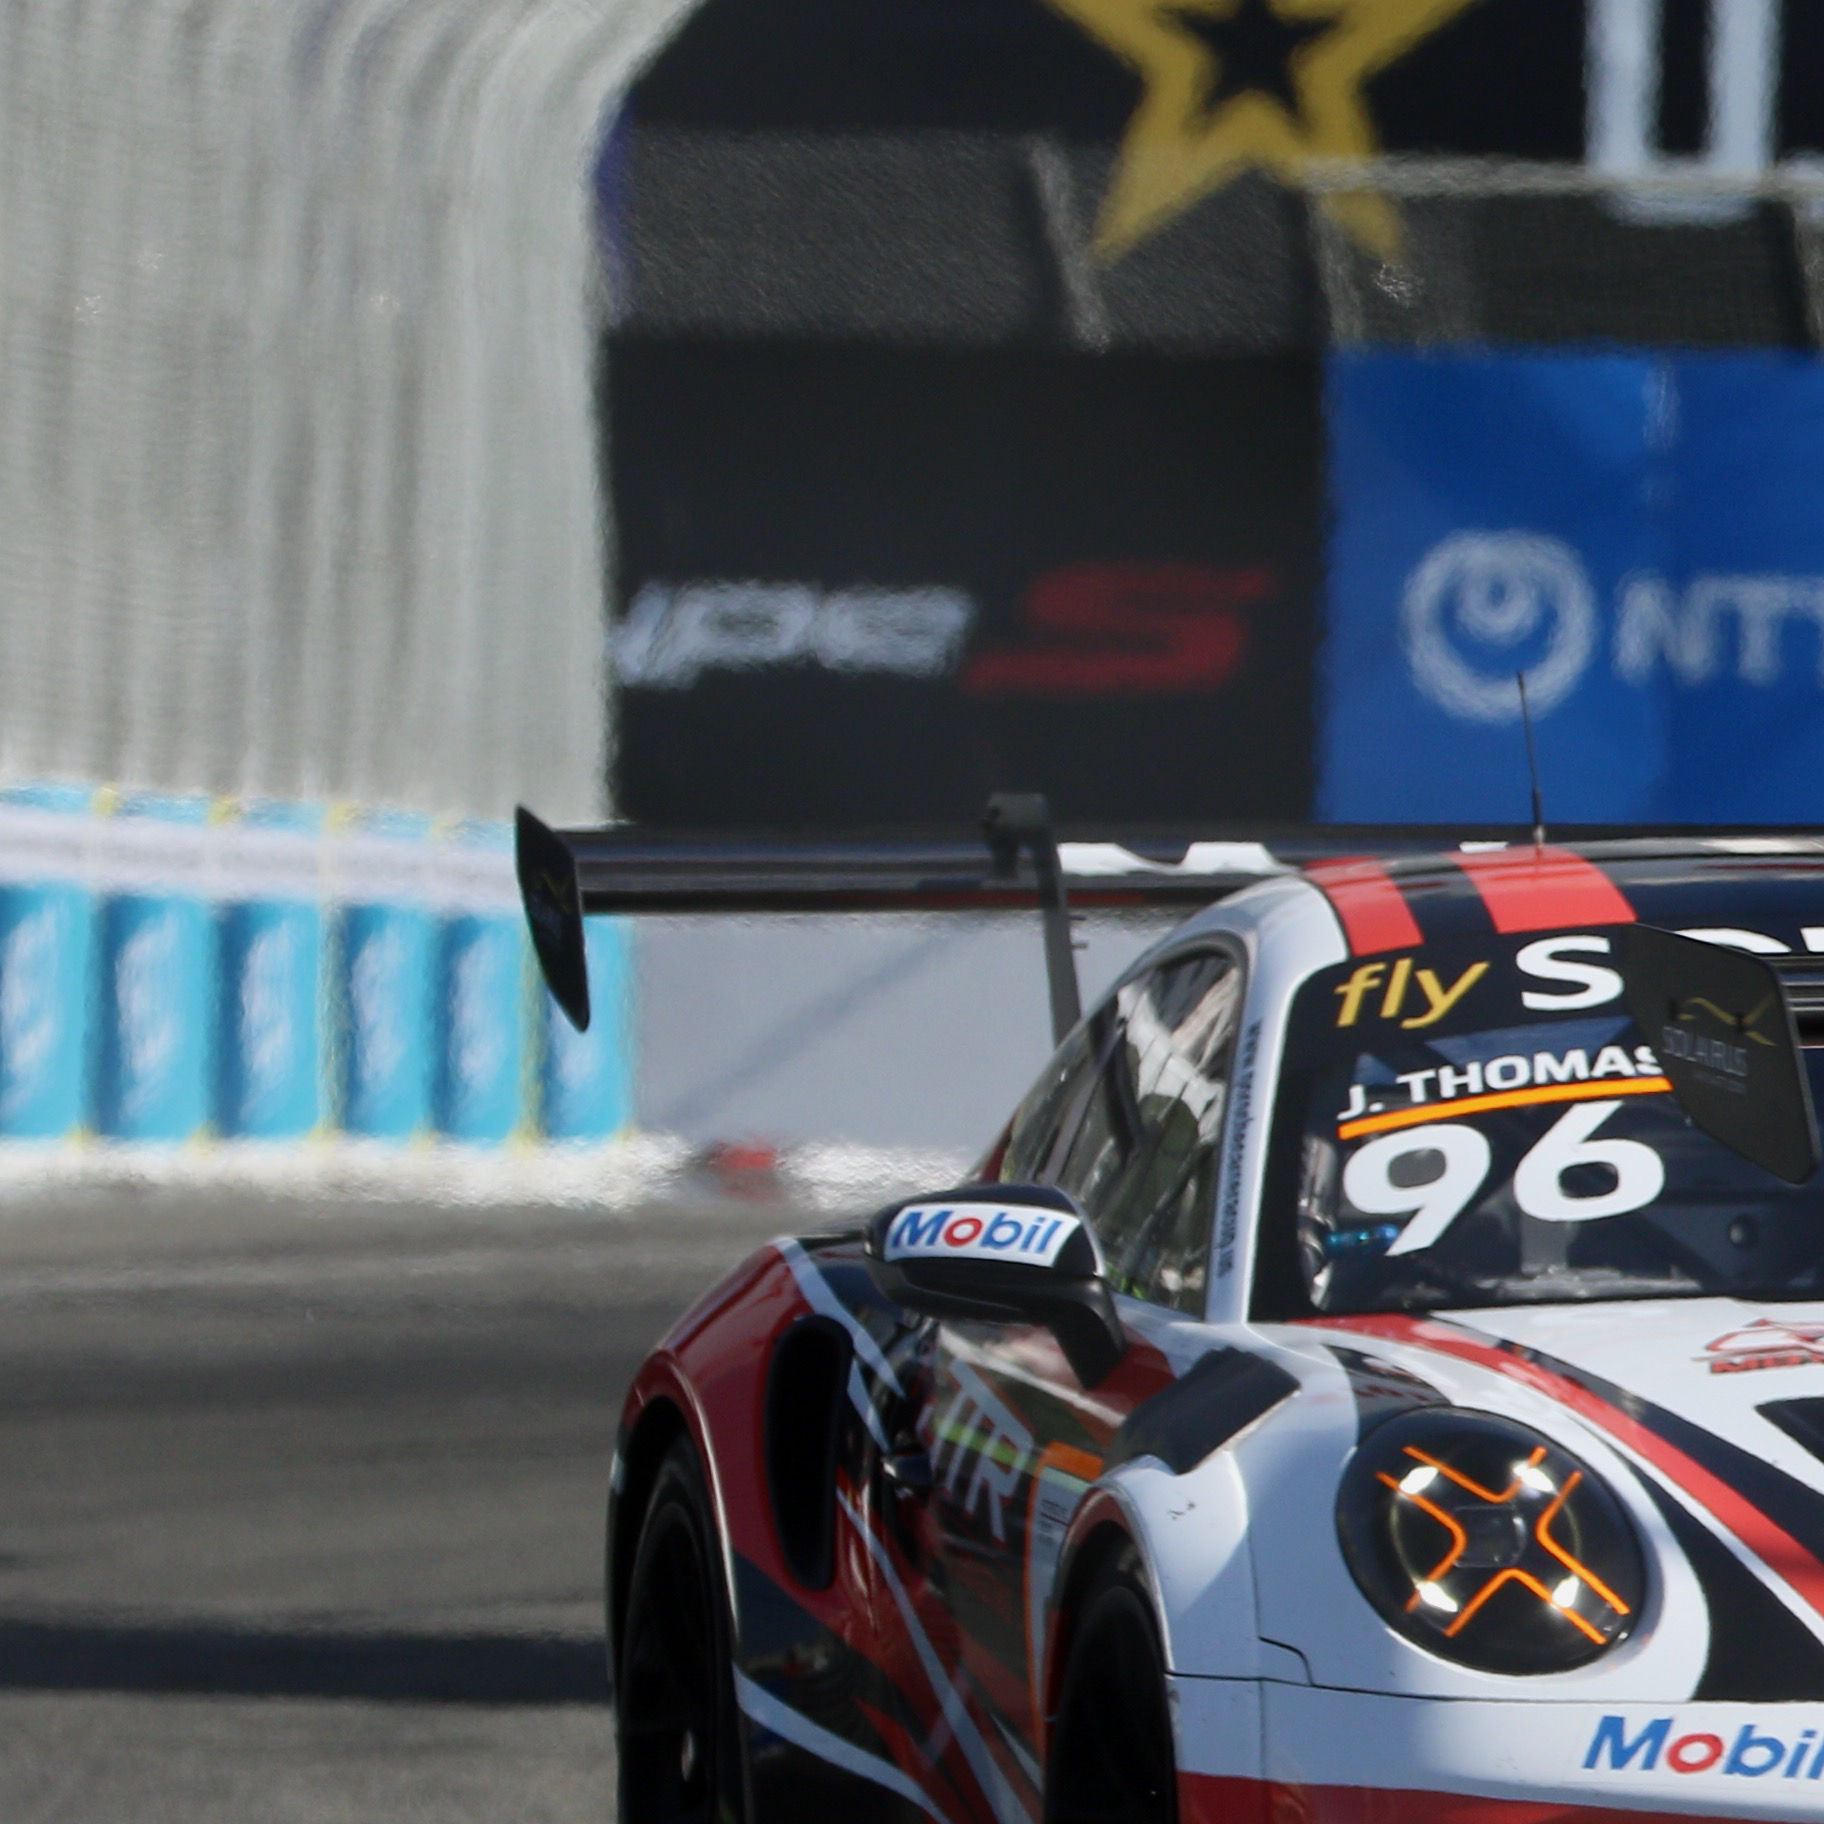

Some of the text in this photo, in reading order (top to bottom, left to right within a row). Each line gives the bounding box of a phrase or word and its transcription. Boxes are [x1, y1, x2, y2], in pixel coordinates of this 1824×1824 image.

[1334, 956, 1490, 1029] fly
[1337, 1083, 1383, 1122] J.
[1398, 1043, 1662, 1104] THOMAS
[1342, 1099, 1664, 1257] 96
[892, 1208, 1064, 1255] Mobil
